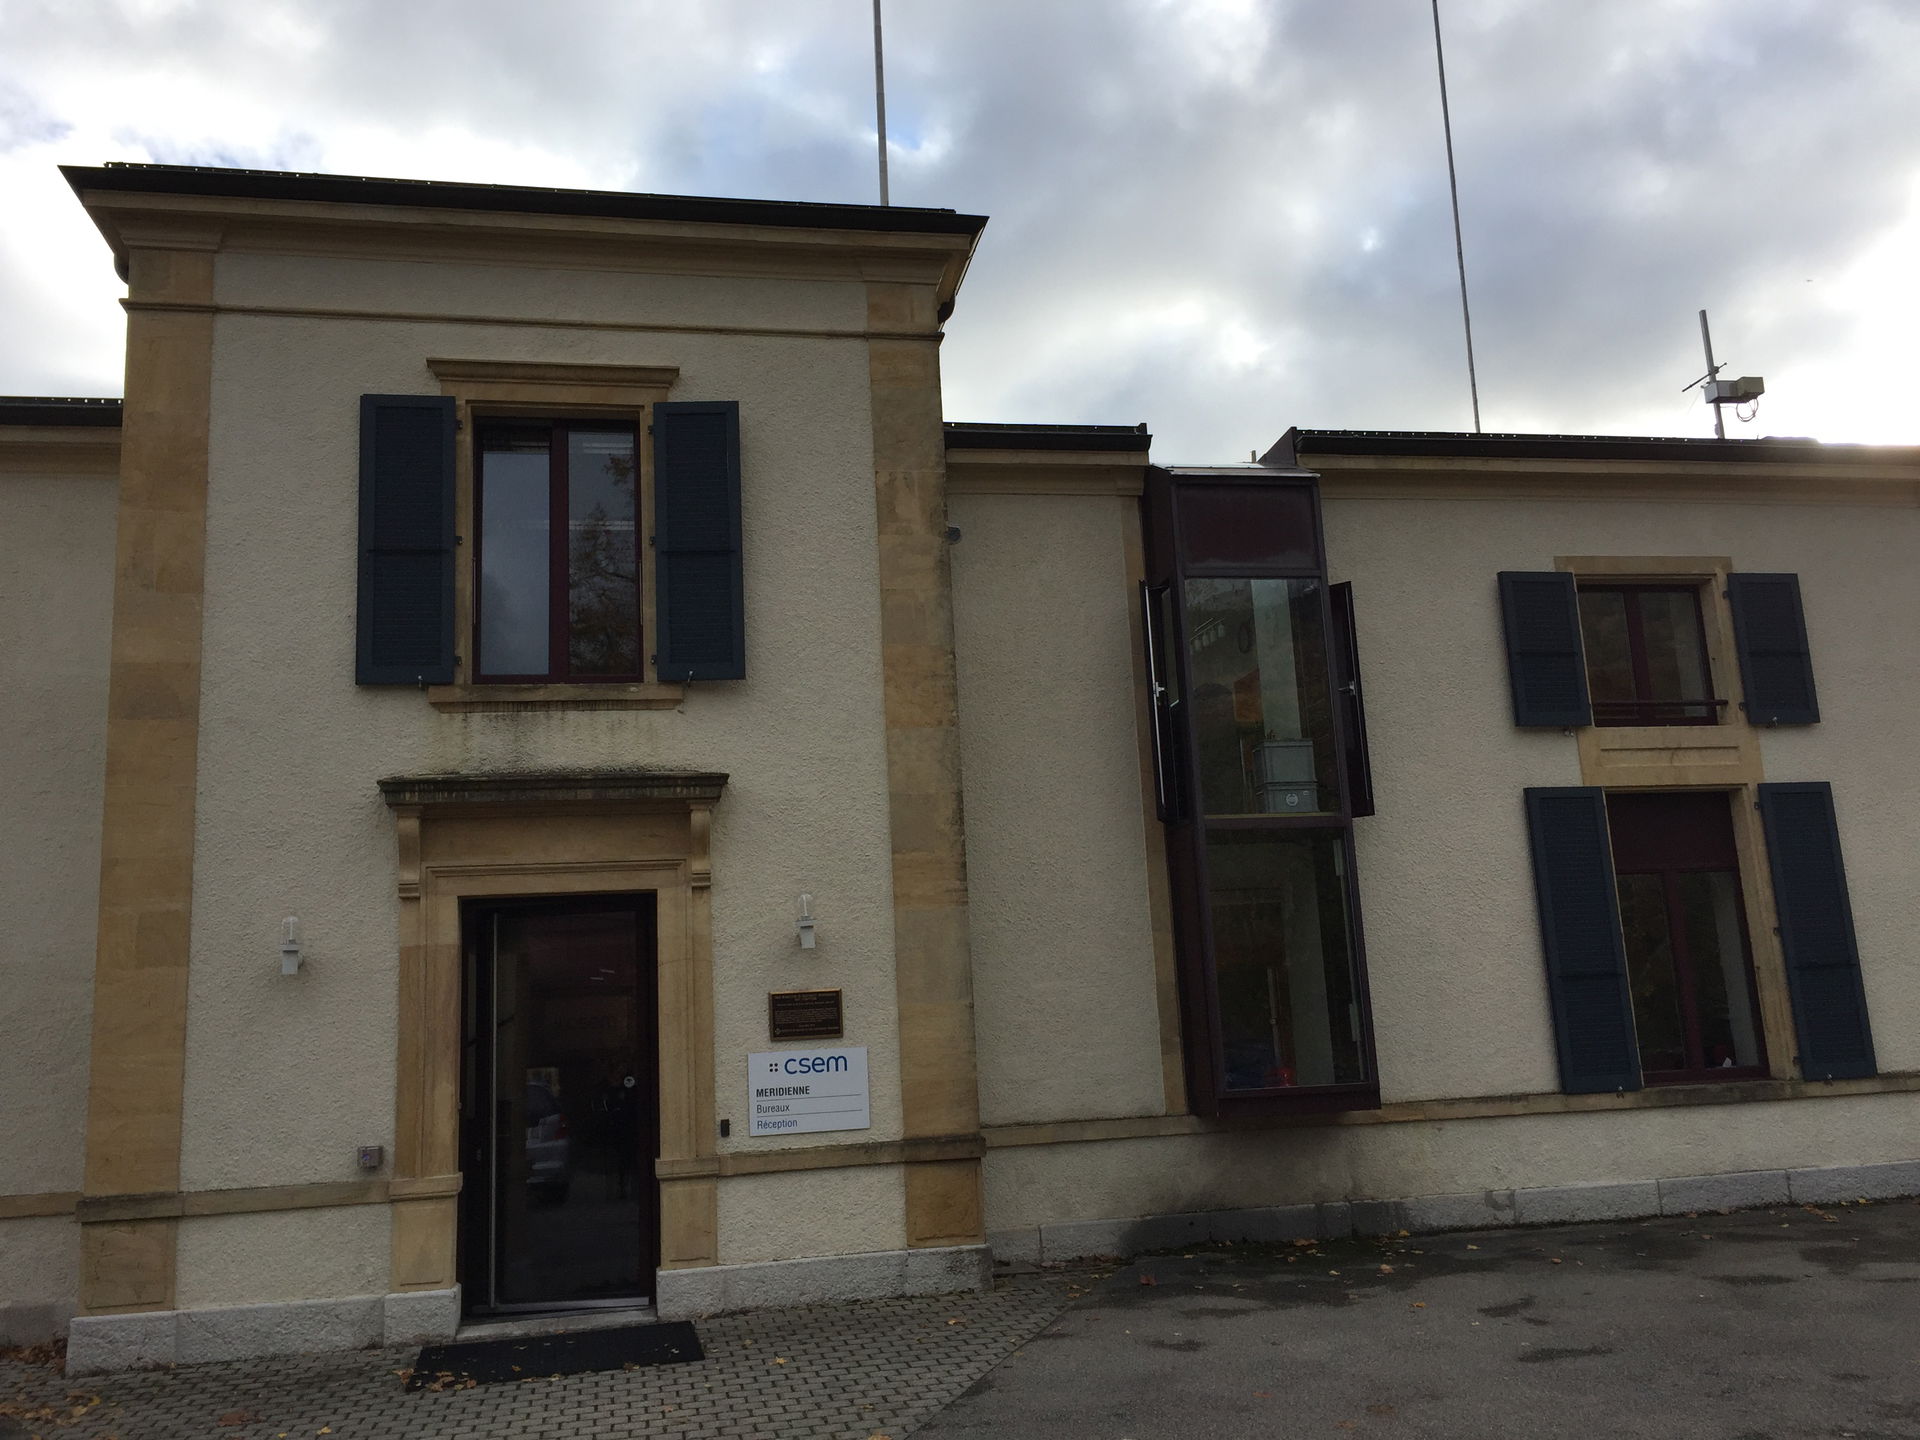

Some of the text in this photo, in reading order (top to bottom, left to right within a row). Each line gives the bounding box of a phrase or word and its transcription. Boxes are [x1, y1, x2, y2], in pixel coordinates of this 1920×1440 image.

[784, 1055, 848, 1075] csem
[756, 1085, 811, 1098] MERIDIENNE
[756, 1103, 790, 1114] Bureaux
[757, 1118, 798, 1130] Réception
